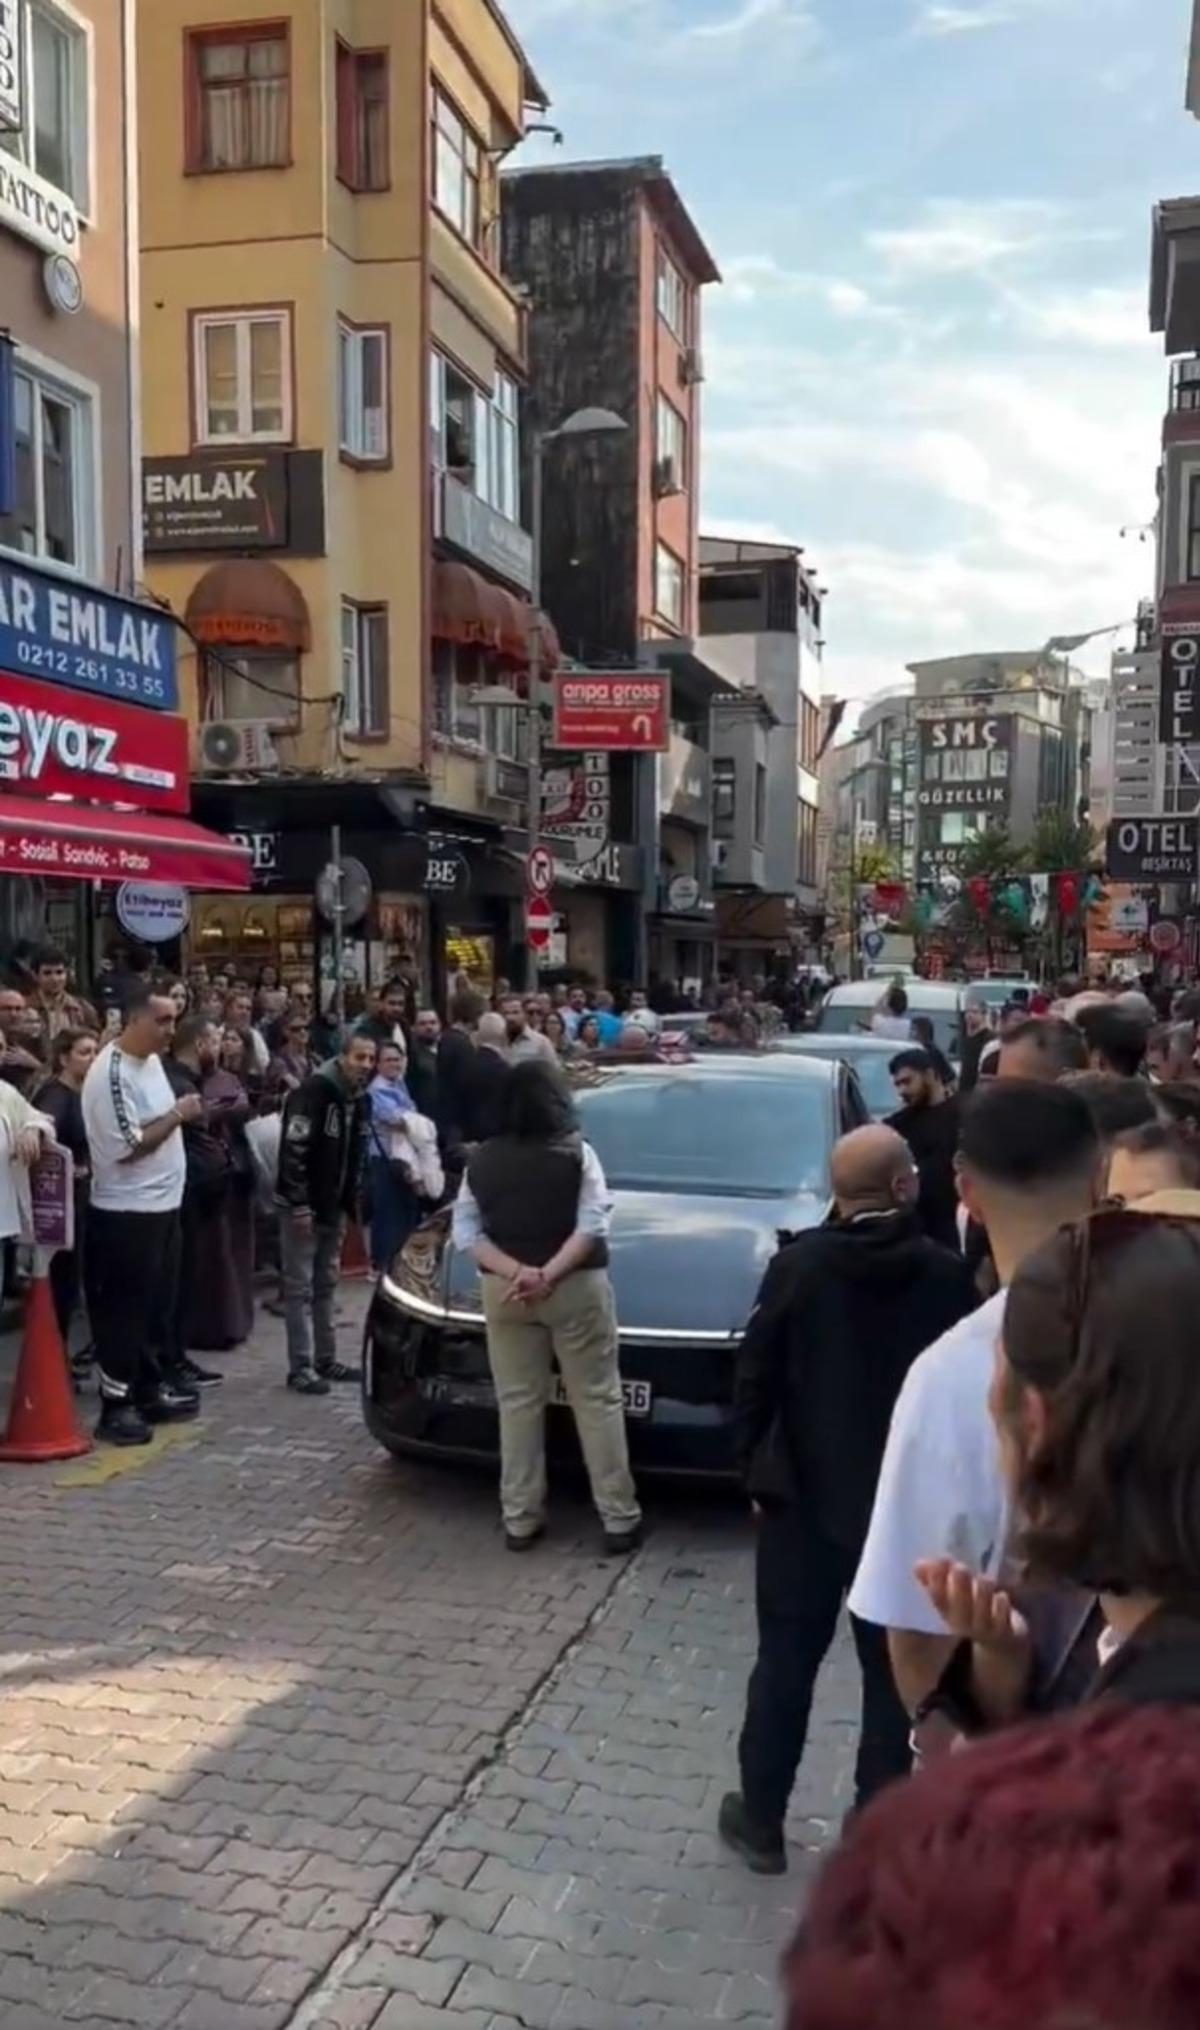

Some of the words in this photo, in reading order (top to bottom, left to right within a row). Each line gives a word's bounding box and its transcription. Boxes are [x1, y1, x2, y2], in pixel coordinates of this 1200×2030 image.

[145, 470, 256, 503] EMLAK
[49, 588, 161, 669] EMLAK
[17, 641, 68, 673] 0212
[75, 656, 108, 683] 261
[115, 668, 137, 691] 33
[143, 676, 163, 698] 55
[612, 684, 660, 706] gross
[1170, 638, 1198, 738] OTEL
[932, 719, 999, 751] SMÇ
[918, 786, 1005, 806] GÜZELLİK
[1118, 822, 1194, 853] OTEL
[425, 859, 457, 883] BE
